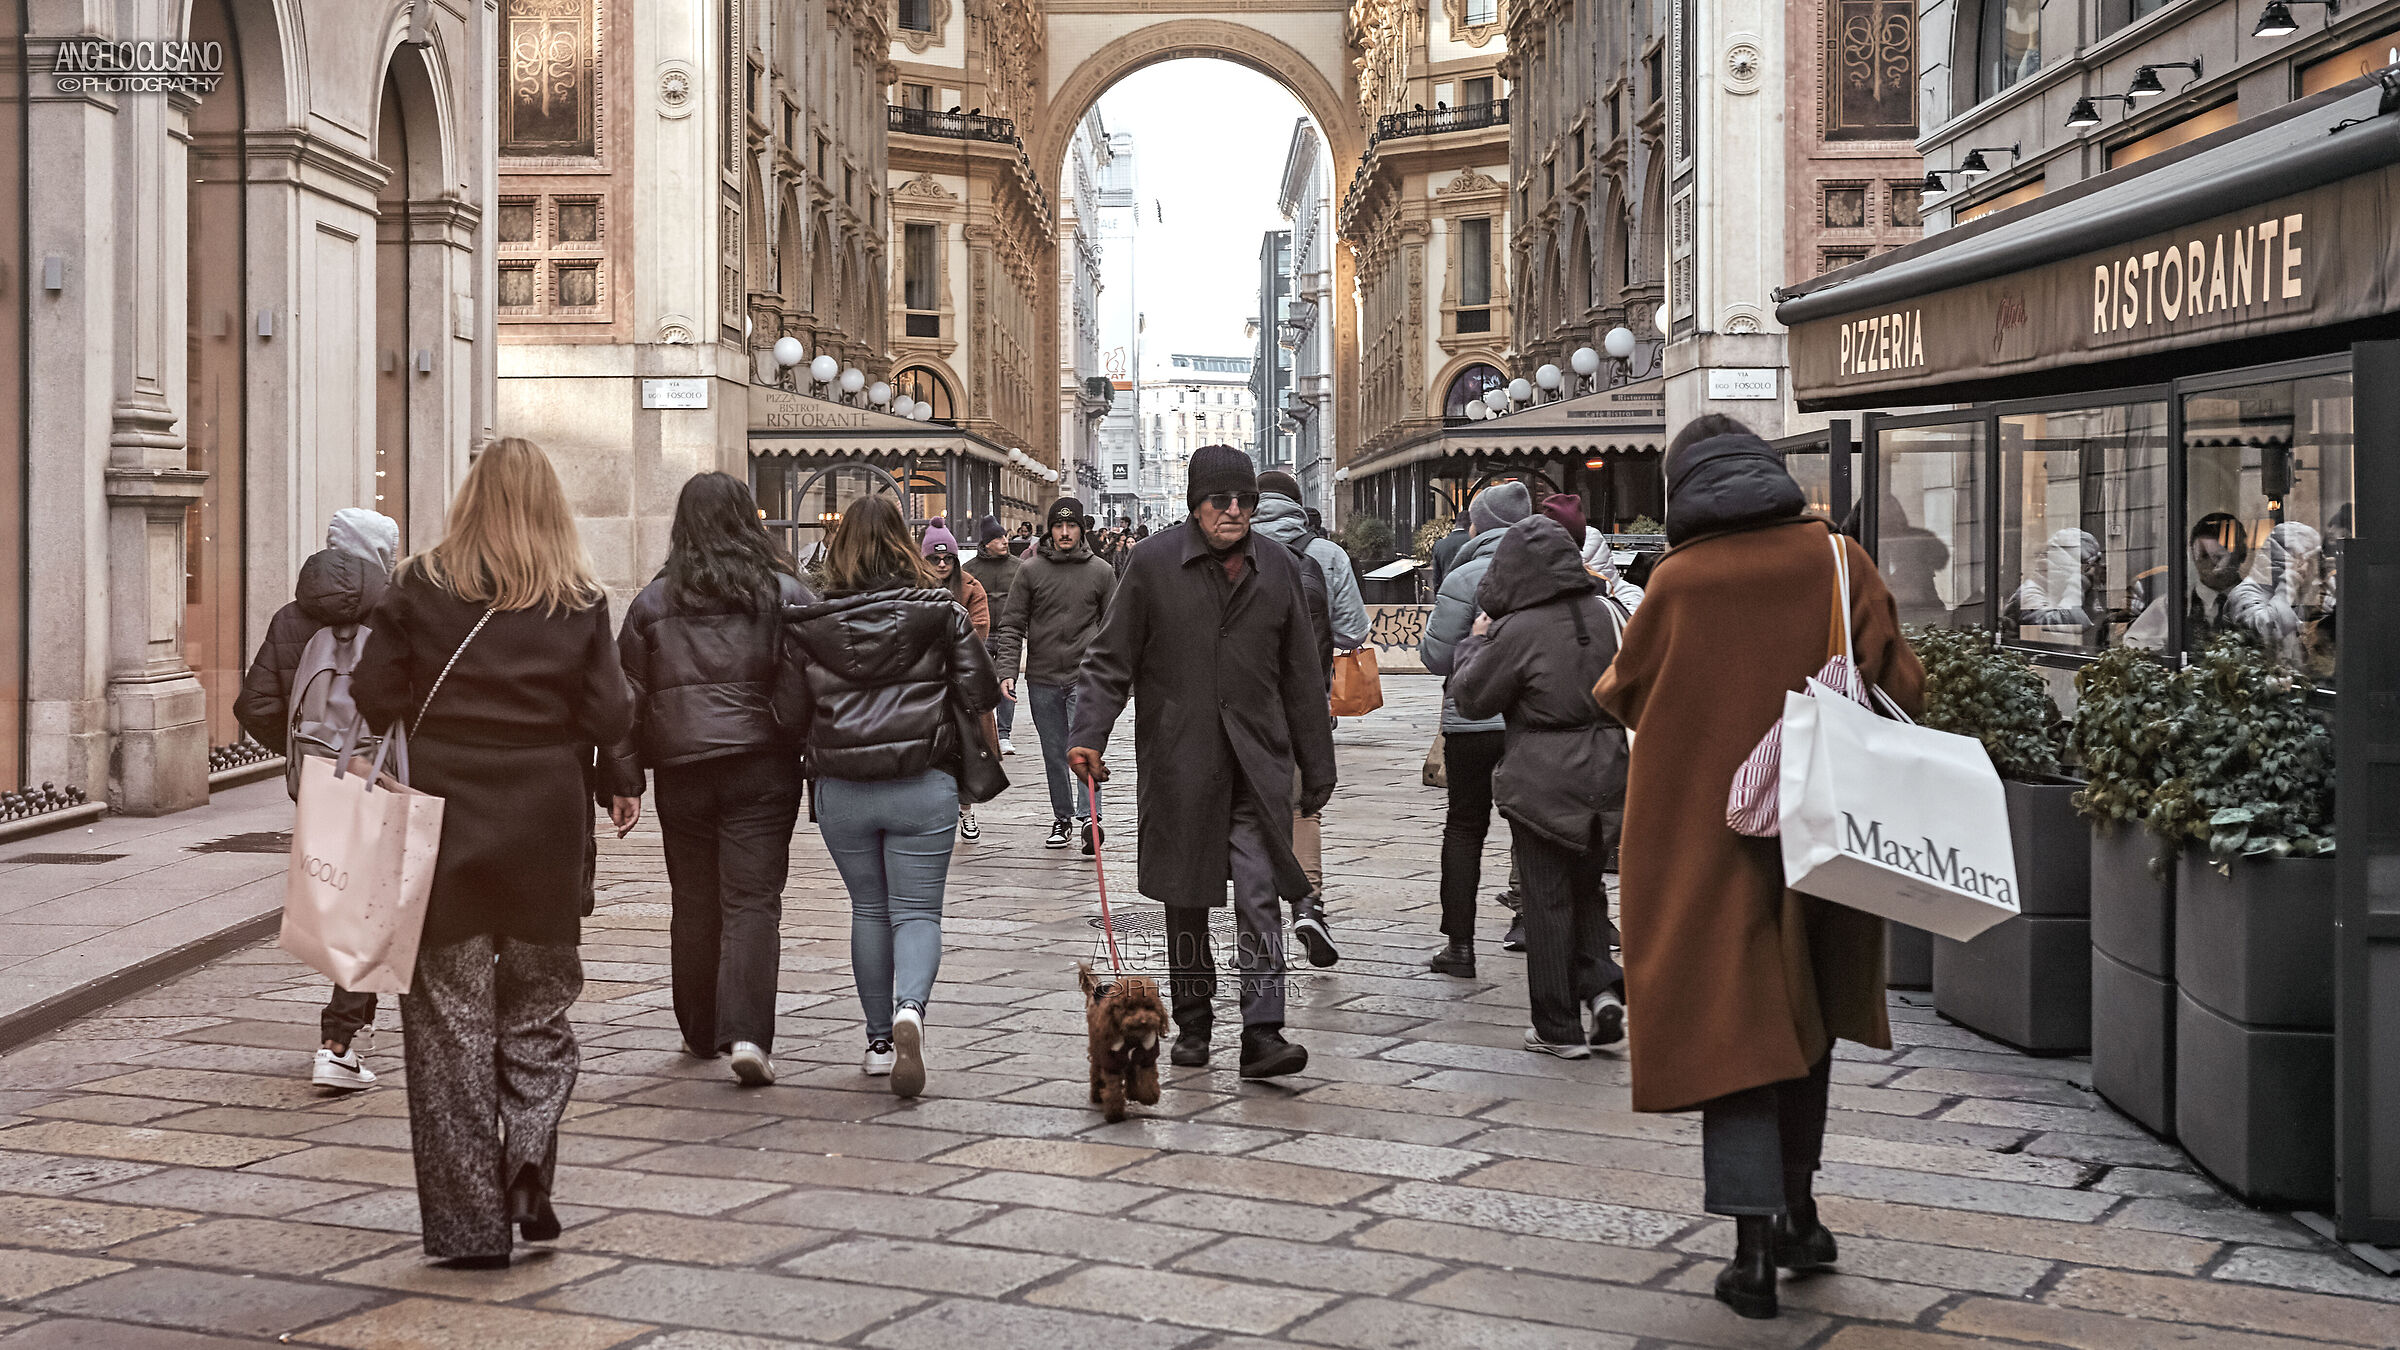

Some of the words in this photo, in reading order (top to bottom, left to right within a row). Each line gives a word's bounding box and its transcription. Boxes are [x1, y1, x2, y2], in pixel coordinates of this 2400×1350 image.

[2093, 213, 2303, 334] RISTORANTE
[1840, 309, 1924, 376] PIZZERIA
[766, 394, 796, 403] PIZZA
[780, 403, 820, 412] BISTROT
[767, 412, 870, 427] RISTORANTE
[1841, 810, 2015, 906] MaxMara
